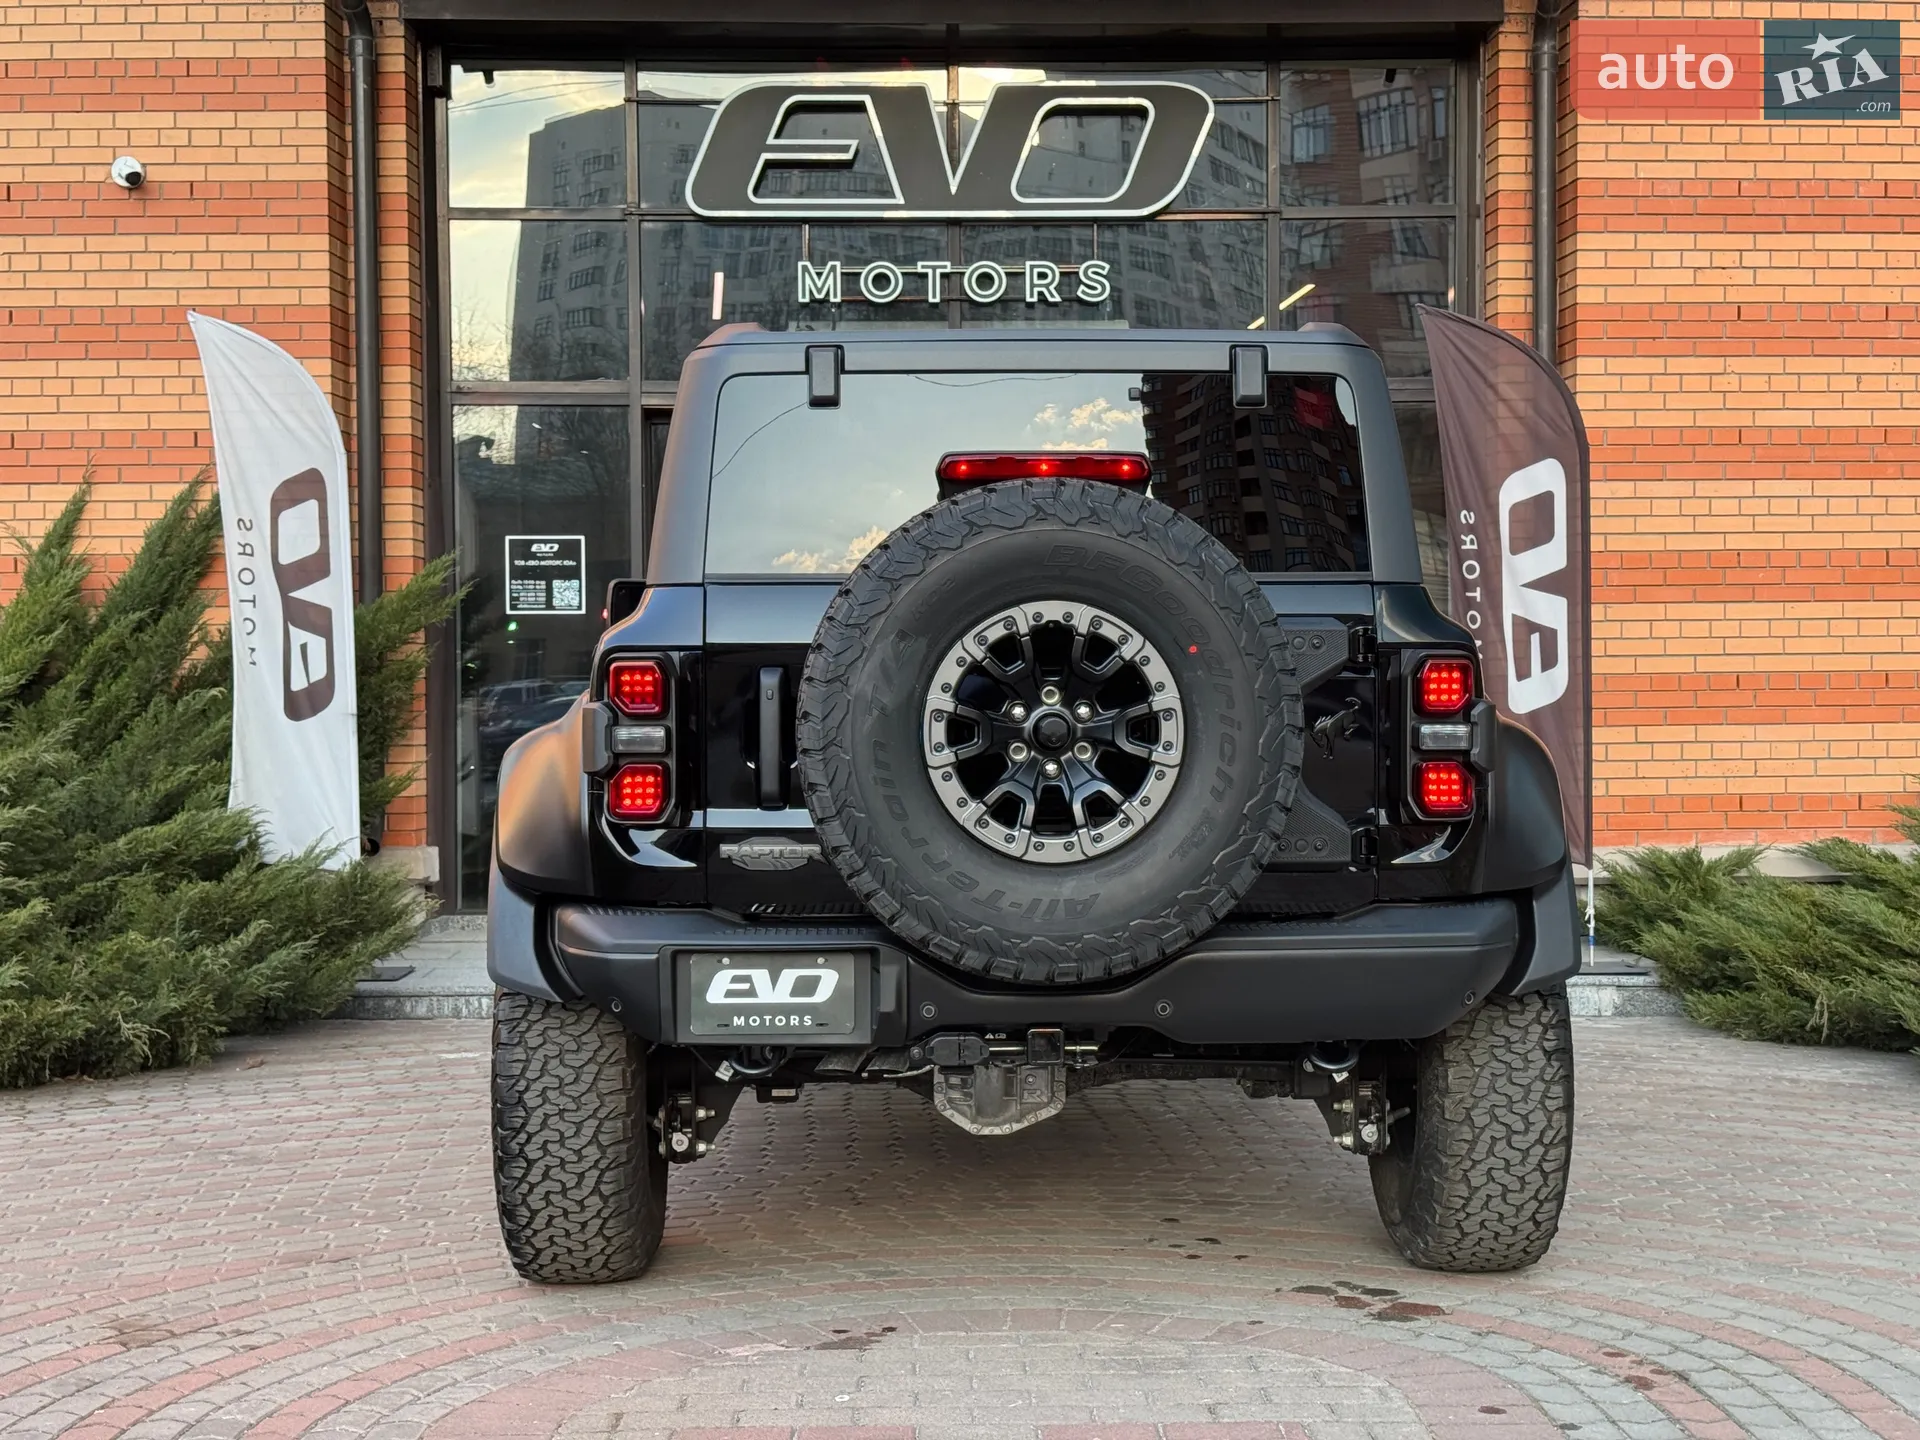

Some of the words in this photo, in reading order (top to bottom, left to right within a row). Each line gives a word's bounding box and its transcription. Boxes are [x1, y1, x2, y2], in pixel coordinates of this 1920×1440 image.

[684, 80, 1215, 218] EVO
[798, 261, 1112, 303] MOTORS
[530, 543, 560, 552] EVO
[1043, 543, 1242, 803] BFGoodrich
[719, 843, 831, 867] RAPTOR
[705, 968, 840, 1004] EVO
[733, 1015, 813, 1027] MOTORS
